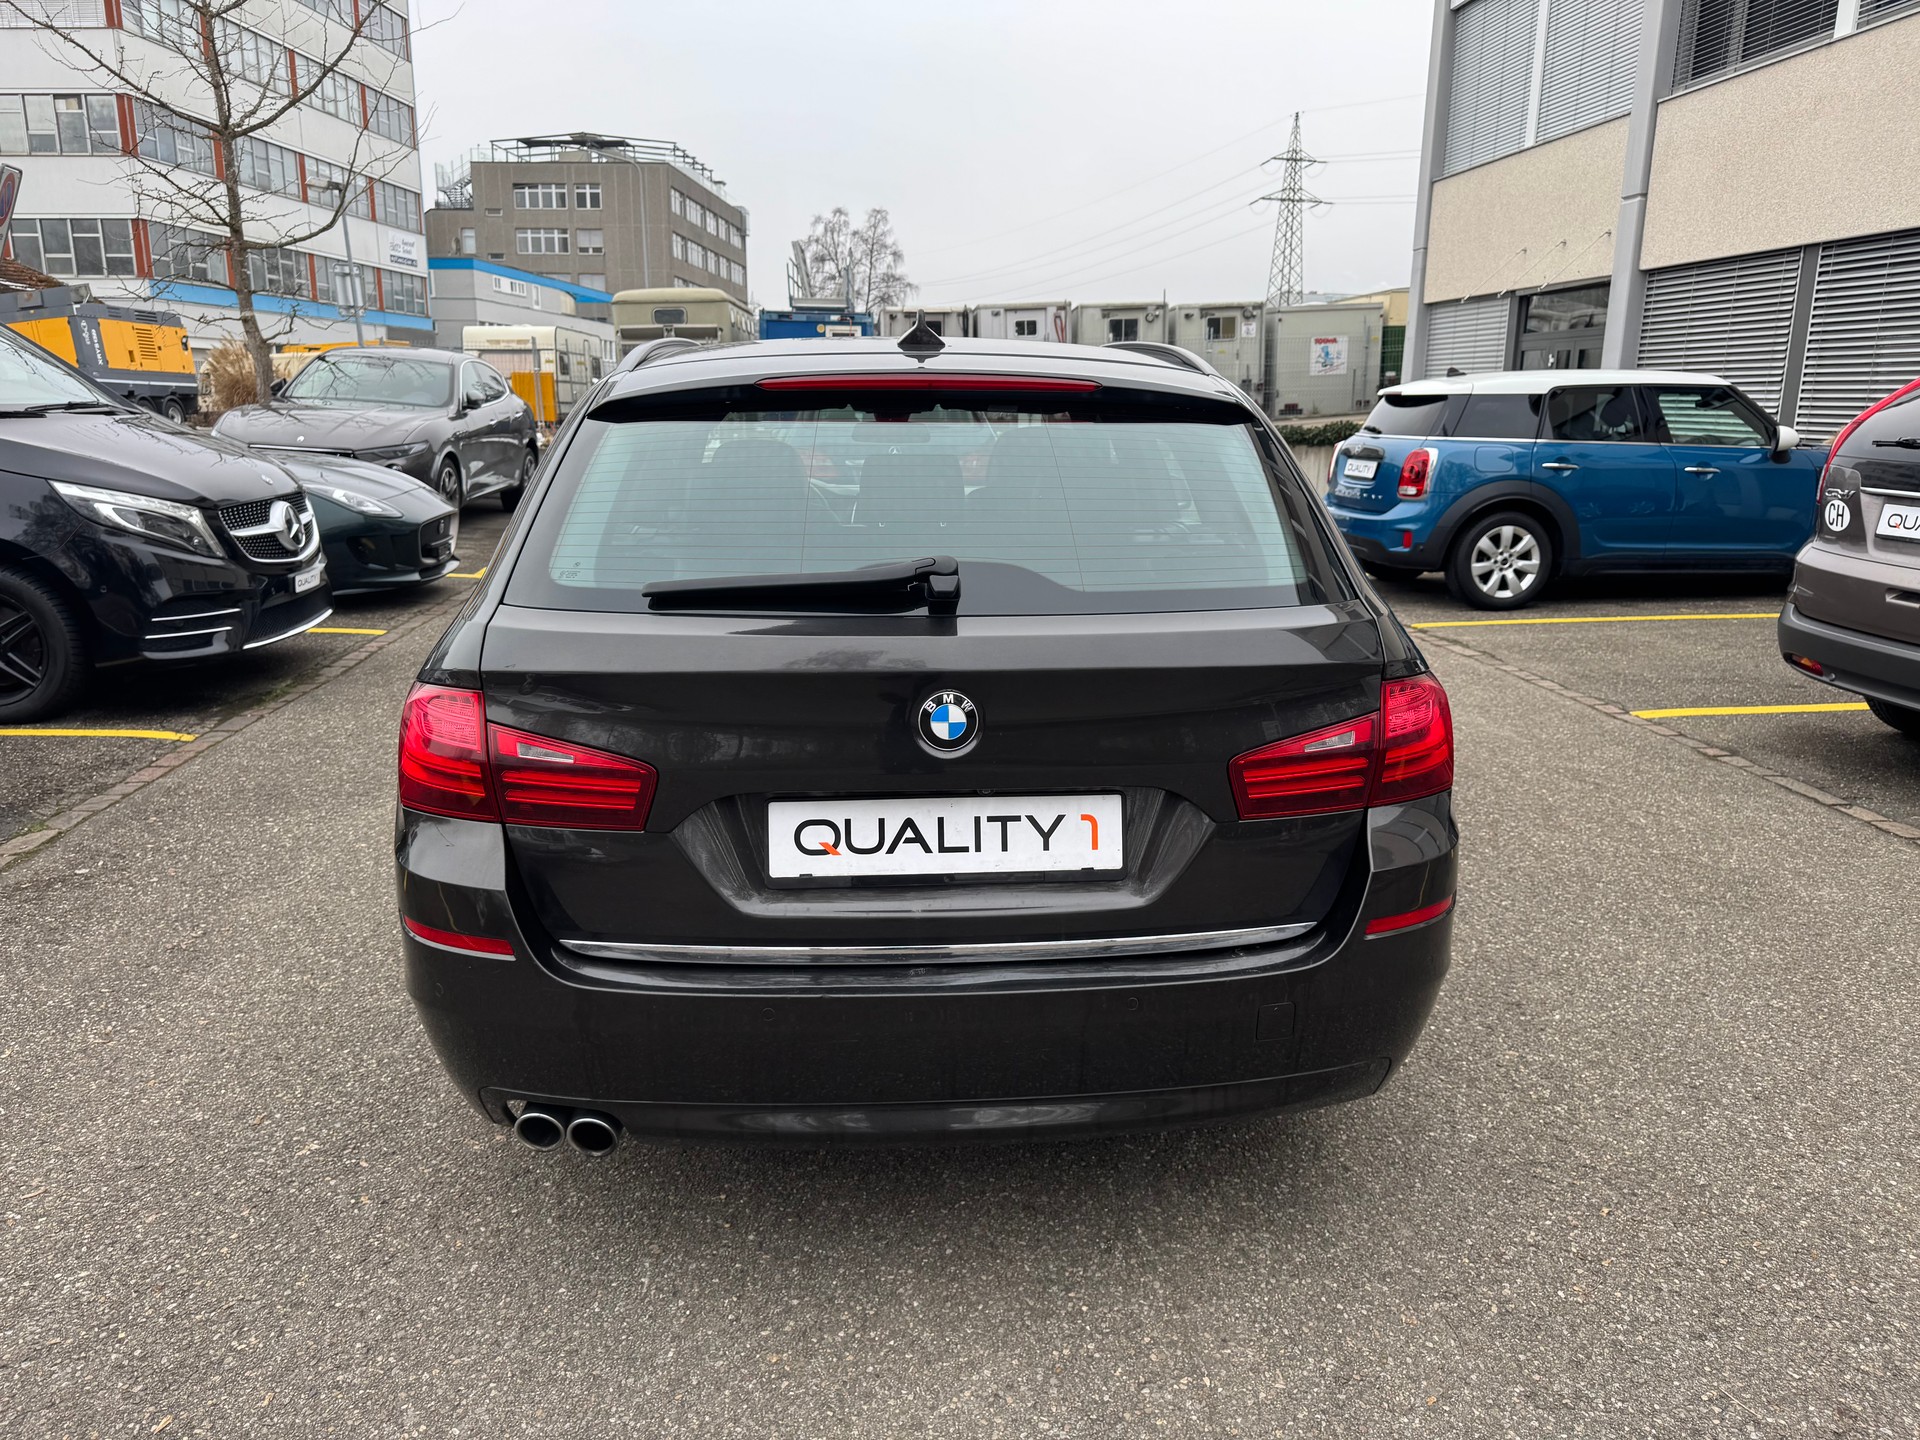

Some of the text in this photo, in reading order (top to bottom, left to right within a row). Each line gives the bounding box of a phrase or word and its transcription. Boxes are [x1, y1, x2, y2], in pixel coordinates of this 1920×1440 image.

[1828, 503, 1845, 528] CH
[924, 693, 974, 713] BMW
[793, 814, 1067, 856] QUALITY
